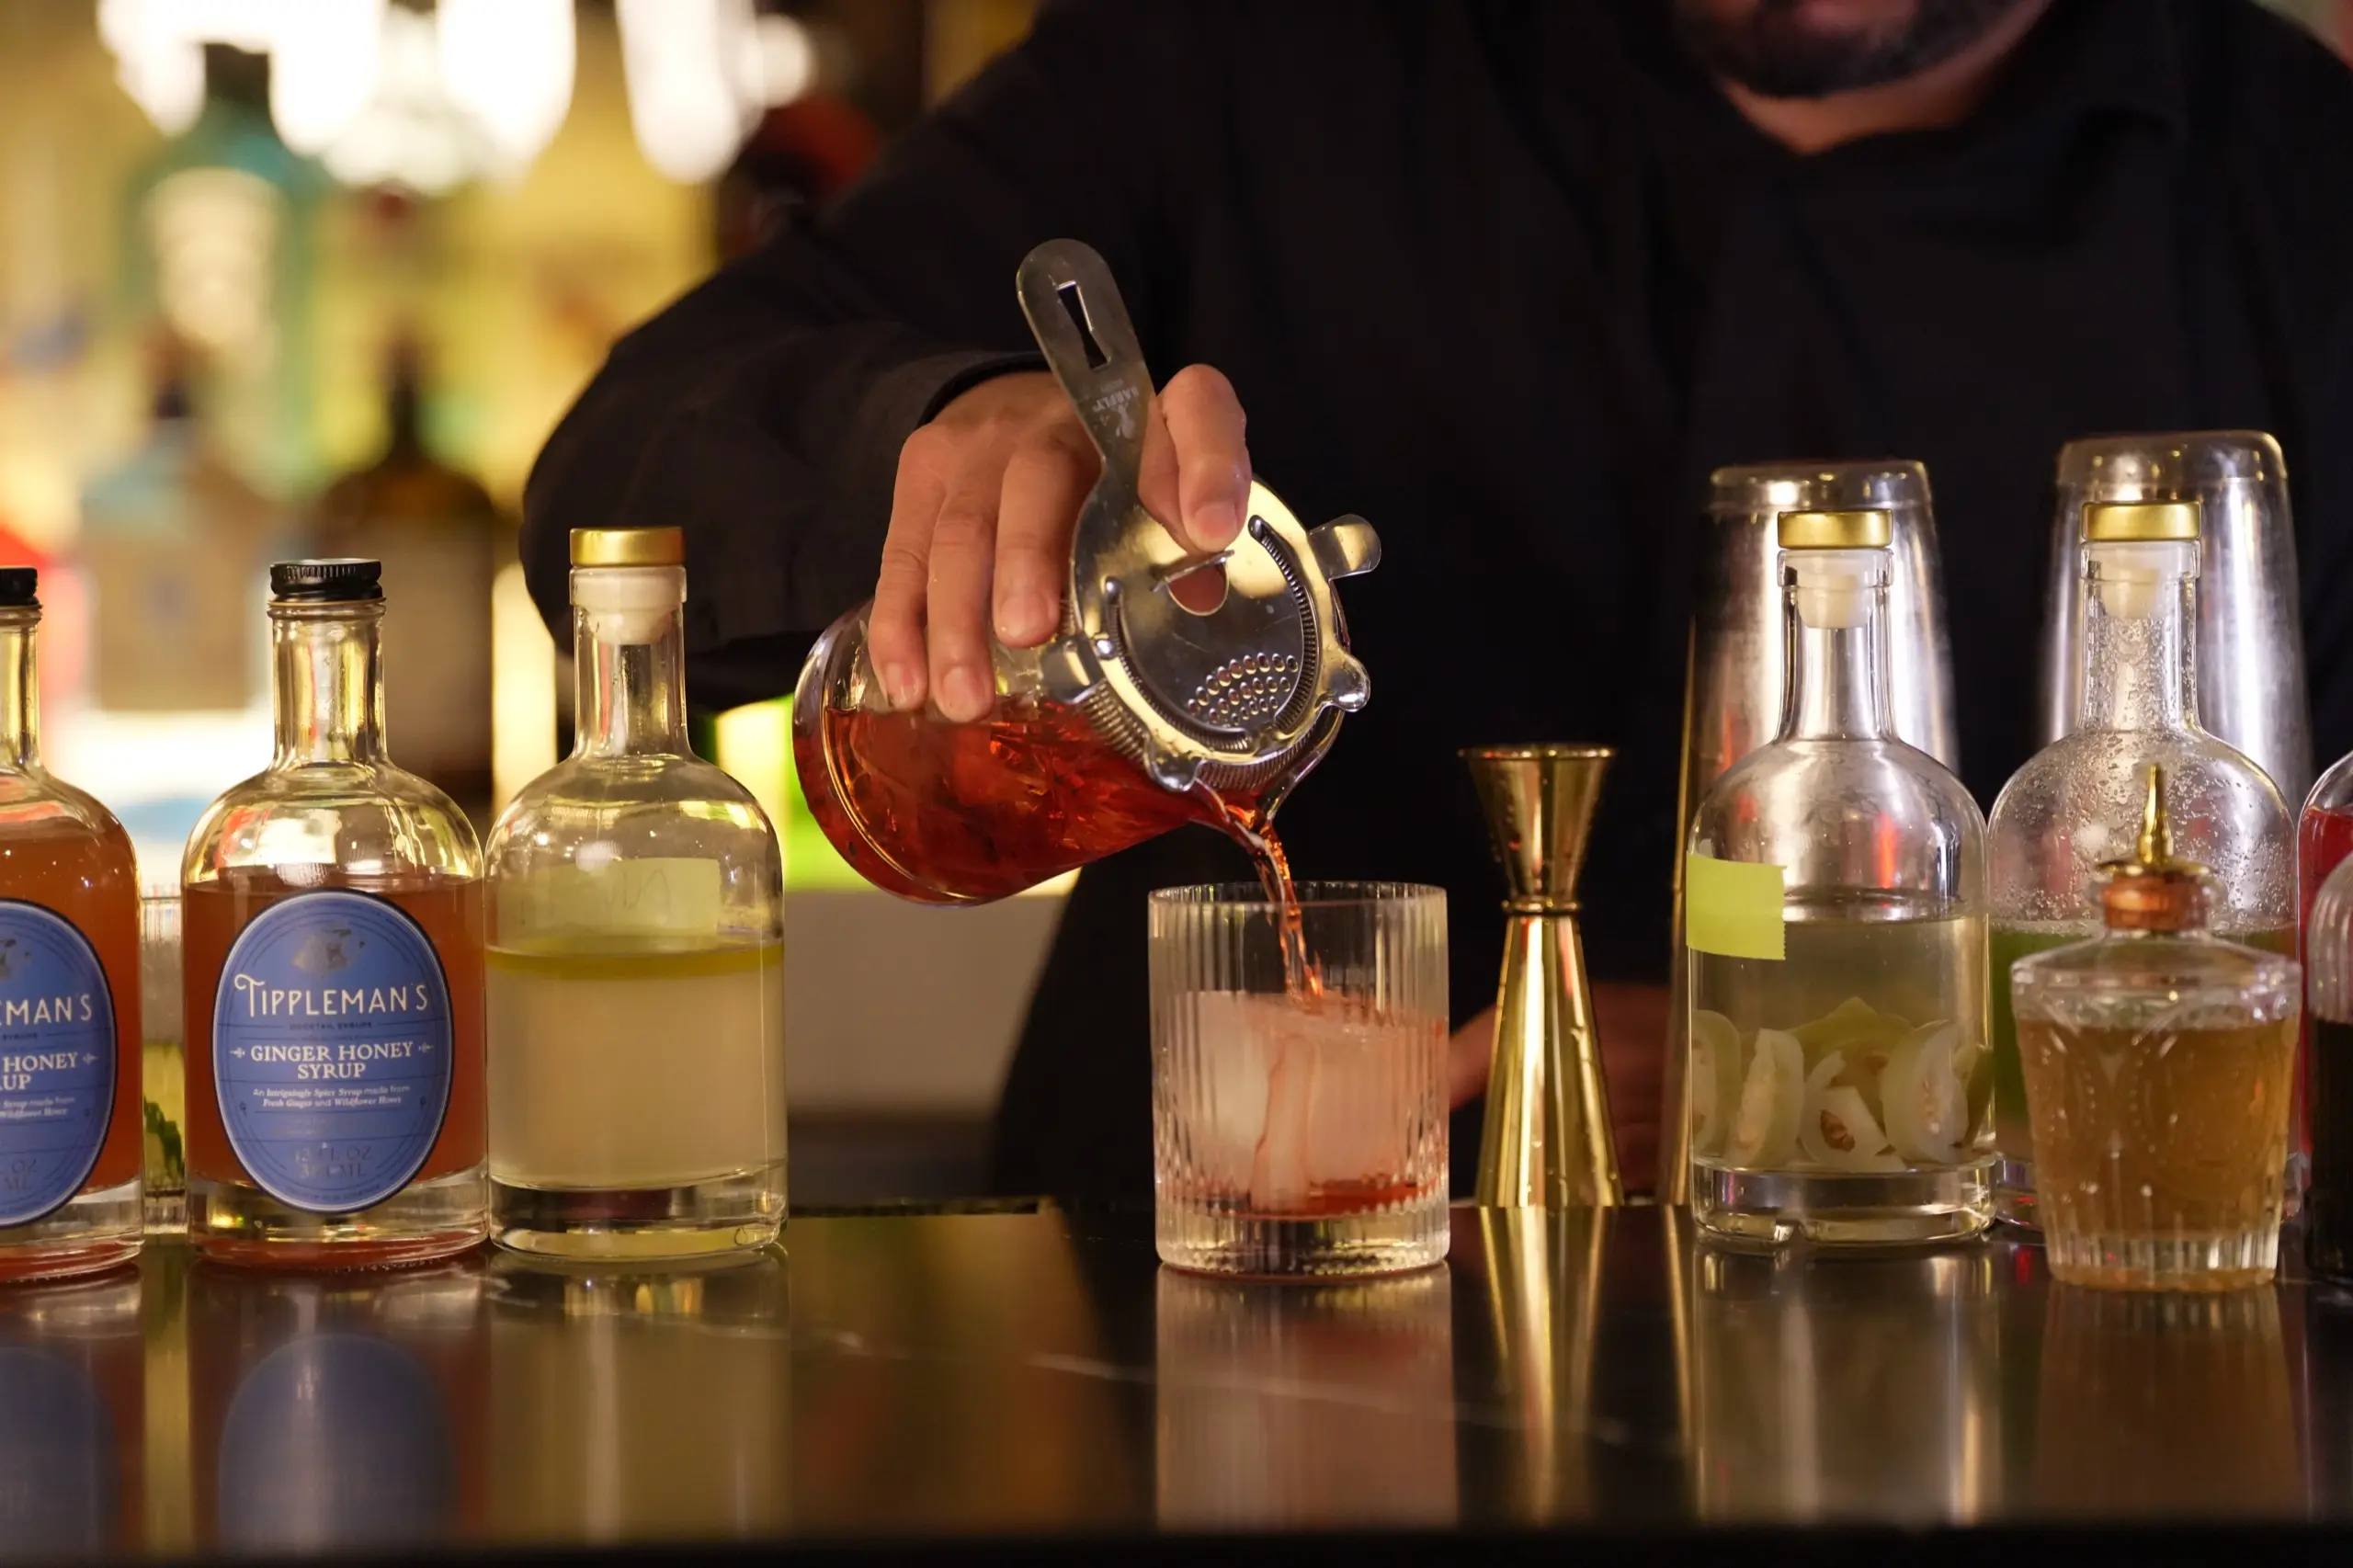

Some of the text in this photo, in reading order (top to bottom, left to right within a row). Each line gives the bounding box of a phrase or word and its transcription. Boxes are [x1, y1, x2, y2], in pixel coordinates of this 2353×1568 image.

[233, 973, 427, 1017] TIPPLEMAN'S
[0, 994, 92, 1026] MAN'S
[3, 1051, 78, 1073] HONEY
[250, 1040, 414, 1062] GINGER HONEY
[297, 1062, 367, 1080] SYRUP
